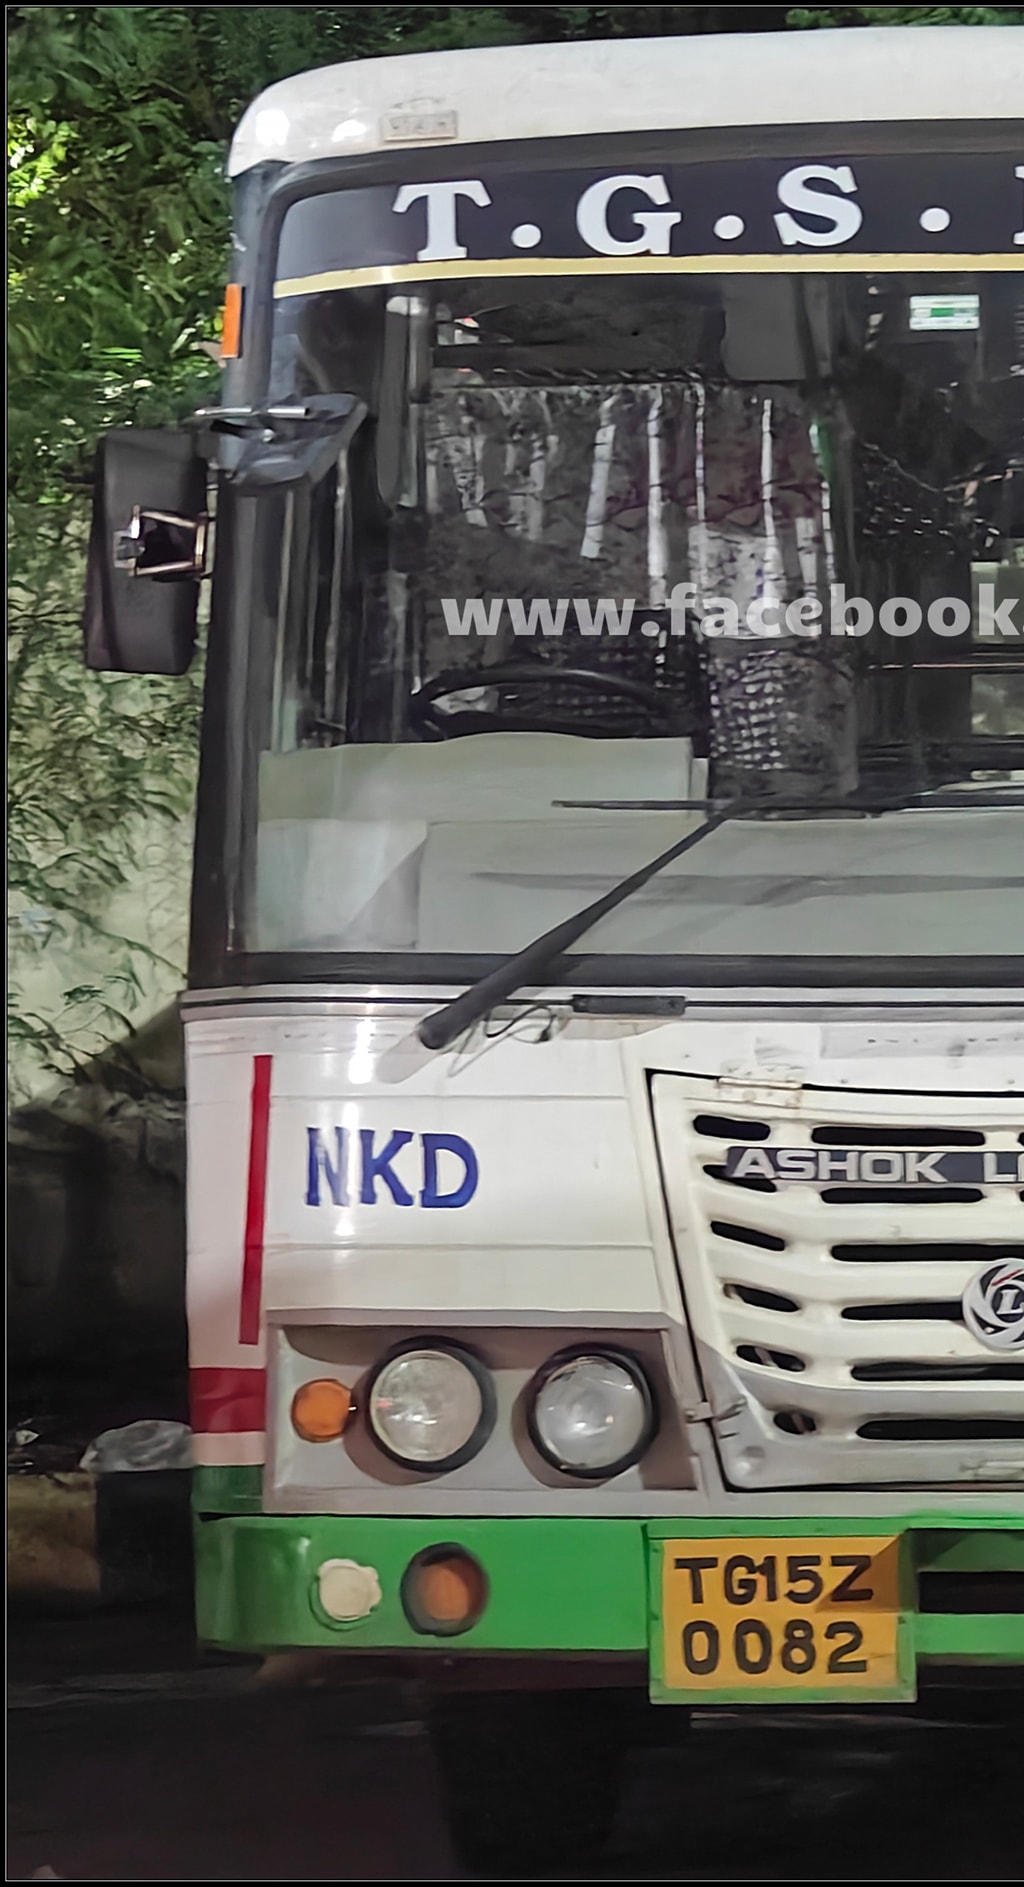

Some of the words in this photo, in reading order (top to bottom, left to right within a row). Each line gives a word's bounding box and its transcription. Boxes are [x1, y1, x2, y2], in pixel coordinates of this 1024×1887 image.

[305, 1125, 478, 1208] NKD
[731, 1148, 947, 1182] ASHOK
[674, 1555, 874, 1605] TG15Z
[682, 1618, 867, 1675] 0082
